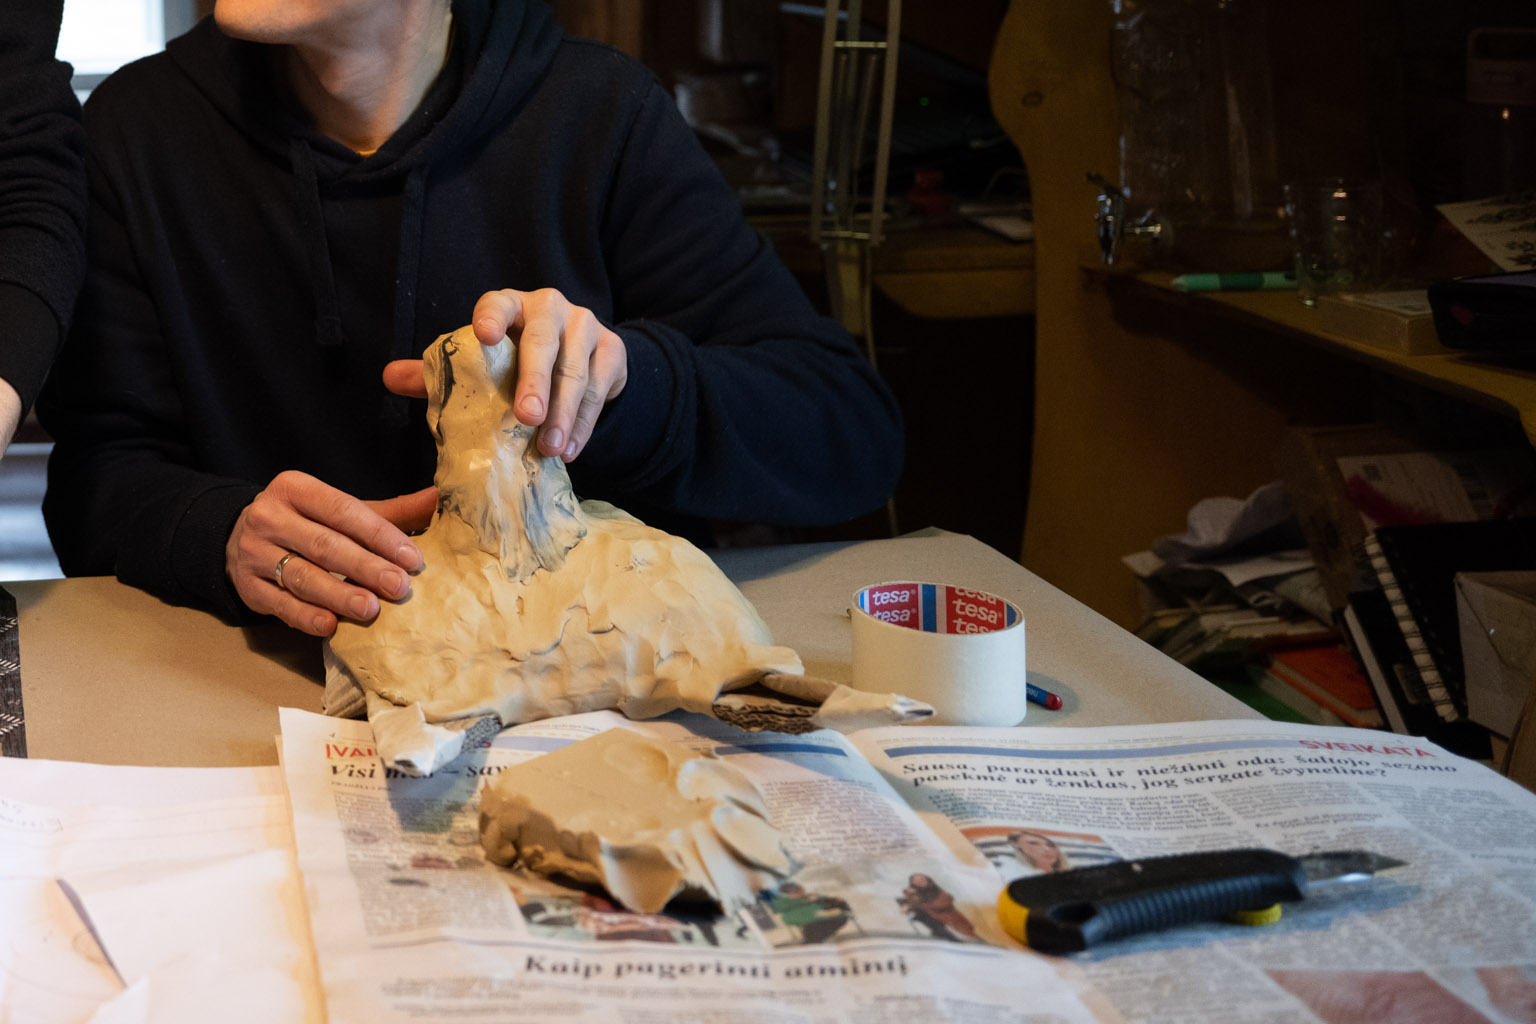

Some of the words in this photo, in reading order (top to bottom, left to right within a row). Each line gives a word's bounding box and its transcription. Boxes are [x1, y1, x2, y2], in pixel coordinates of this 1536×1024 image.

[872, 590, 910, 606] tesa
[952, 598, 998, 625] tesa
[1298, 739, 1437, 758] SVEIKATA
[331, 763, 376, 779] Visi
[903, 763, 976, 774] Sausa,
[986, 764, 1097, 777] paraudusi
[1108, 767, 1126, 777] ir
[1237, 756, 1284, 767] oda:
[1293, 754, 1370, 768] šaltojo
[1381, 760, 1457, 774] sezono
[1015, 777, 1038, 785] ar
[1141, 777, 1179, 791] jog
[1183, 769, 1264, 784] sergate
[525, 954, 603, 979] Kaip
[614, 957, 771, 979] pagerinti
